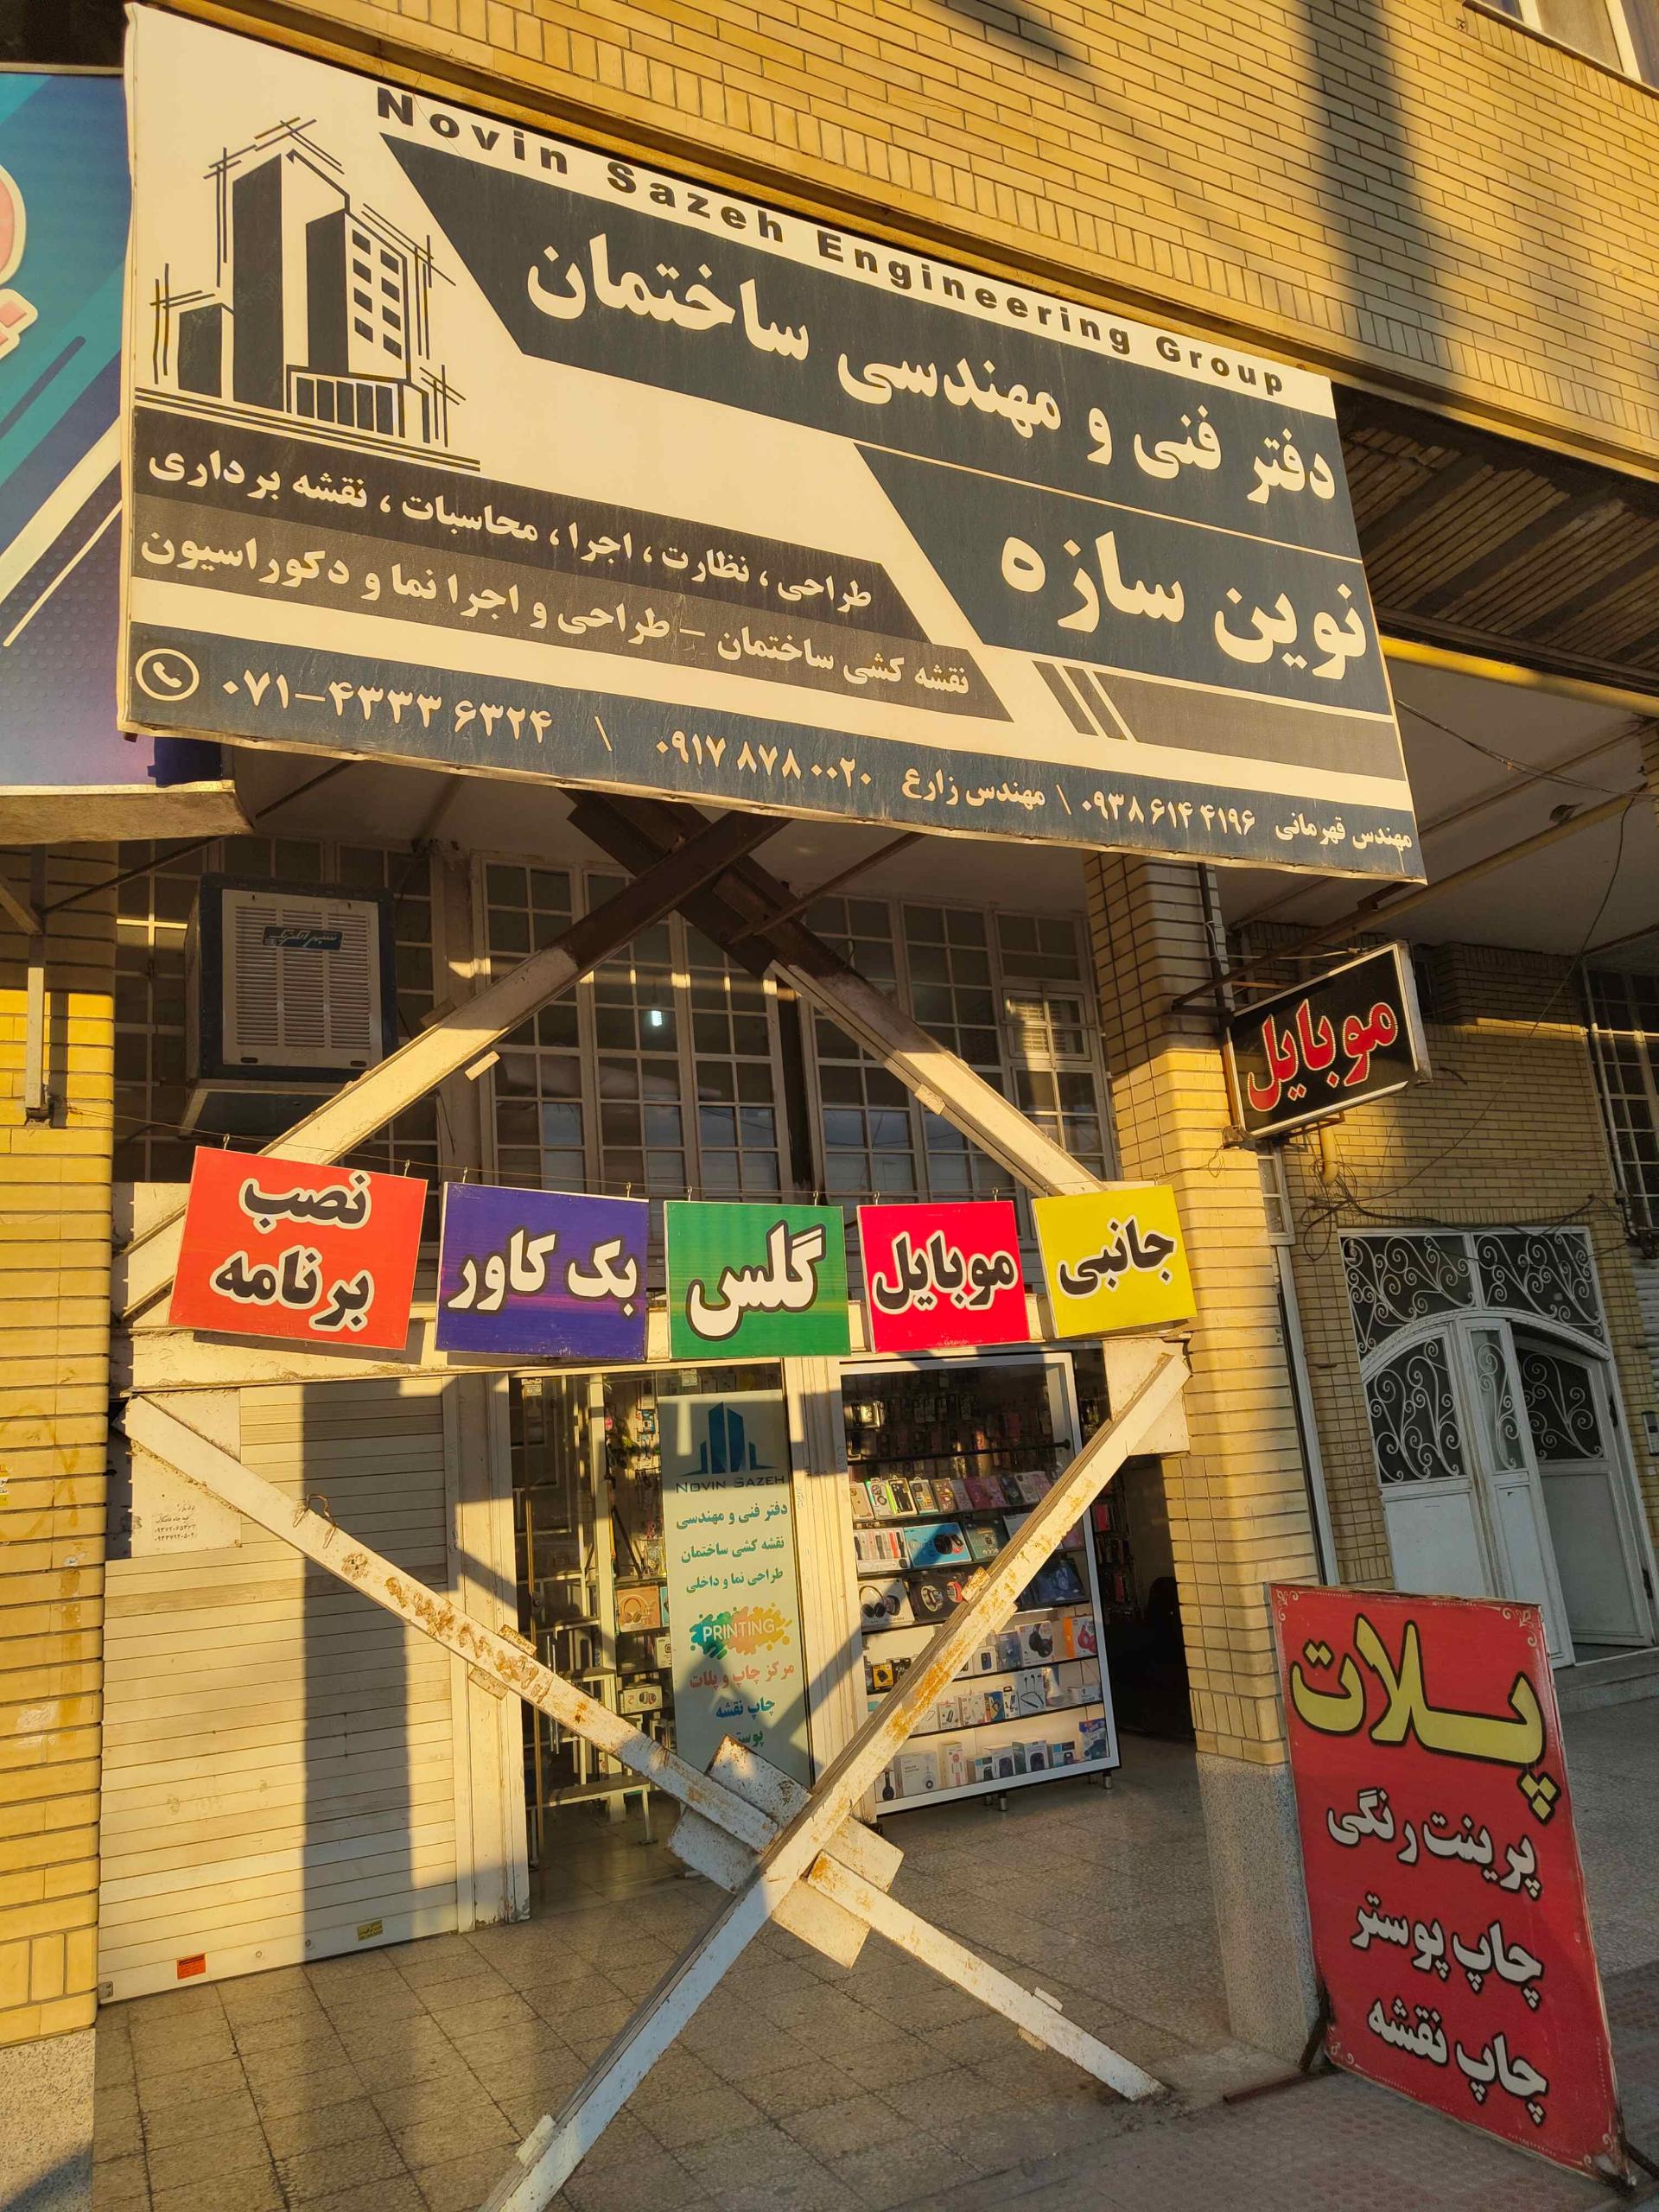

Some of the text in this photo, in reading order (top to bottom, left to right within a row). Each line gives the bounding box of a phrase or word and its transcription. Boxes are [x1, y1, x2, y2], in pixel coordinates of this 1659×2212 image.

[378, 87, 1285, 397] Novin Sazeh Engineering Group
[525, 232, 1336, 505] دفتر فنی و مهندسی ساختمان
[292, 472, 367, 508] نقشه
[402, 495, 538, 541] محاسبات
[141, 531, 350, 588] دکوراسیون
[569, 521, 632, 564] اجرا
[391, 564, 438, 600] نما
[663, 546, 750, 583] نظارت
[360, 572, 381, 601] و
[448, 574, 519, 620] اجرا
[778, 575, 872, 613] طراحی
[1001, 531, 1368, 681] نوین سازه
[530, 598, 548, 629] و
[557, 603, 671, 645] طراحی
[717, 626, 835, 671] ساختمان
[843, 652, 905, 684] کشی
[914, 664, 969, 695] نقشه
[901, 766, 959, 806] زارع
[966, 779, 1046, 811] مهندس
[1275, 810, 1346, 847] قهرمانی
[1352, 830, 1414, 854] مهندس
[1247, 998, 1398, 1112] موبایل
[240, 1171, 371, 1232] نصب
[446, 1229, 639, 1319] بک کاور
[872, 1230, 1018, 1314] موبایل
[1057, 1215, 1178, 1300] جانبی
[210, 1246, 374, 1331] برنامه
[687, 1221, 827, 1340] گلس
[676, 1475, 785, 1493] NOVIN SAZEH
[677, 1501, 788, 1529] دفتر فنی و مهندسی
[681, 1535, 785, 1563] نقشه کشی ساختمان
[686, 1567, 783, 1593] طراحی نما و داخلی
[702, 1618, 775, 1643] PRINTING
[722, 1674, 729, 1688] و
[733, 1664, 760, 1687] چاپ
[766, 1662, 795, 1682] مرکز
[715, 1696, 775, 1719] چاپ نقشه
[1290, 1613, 1560, 1821] پلات
[736, 1730, 764, 1747] پوست
[1327, 1787, 1543, 1899] پرینت رنگی
[1351, 1893, 1544, 2008] چاپ پوستر
[1367, 1997, 1548, 2124] چاپ نقشه
